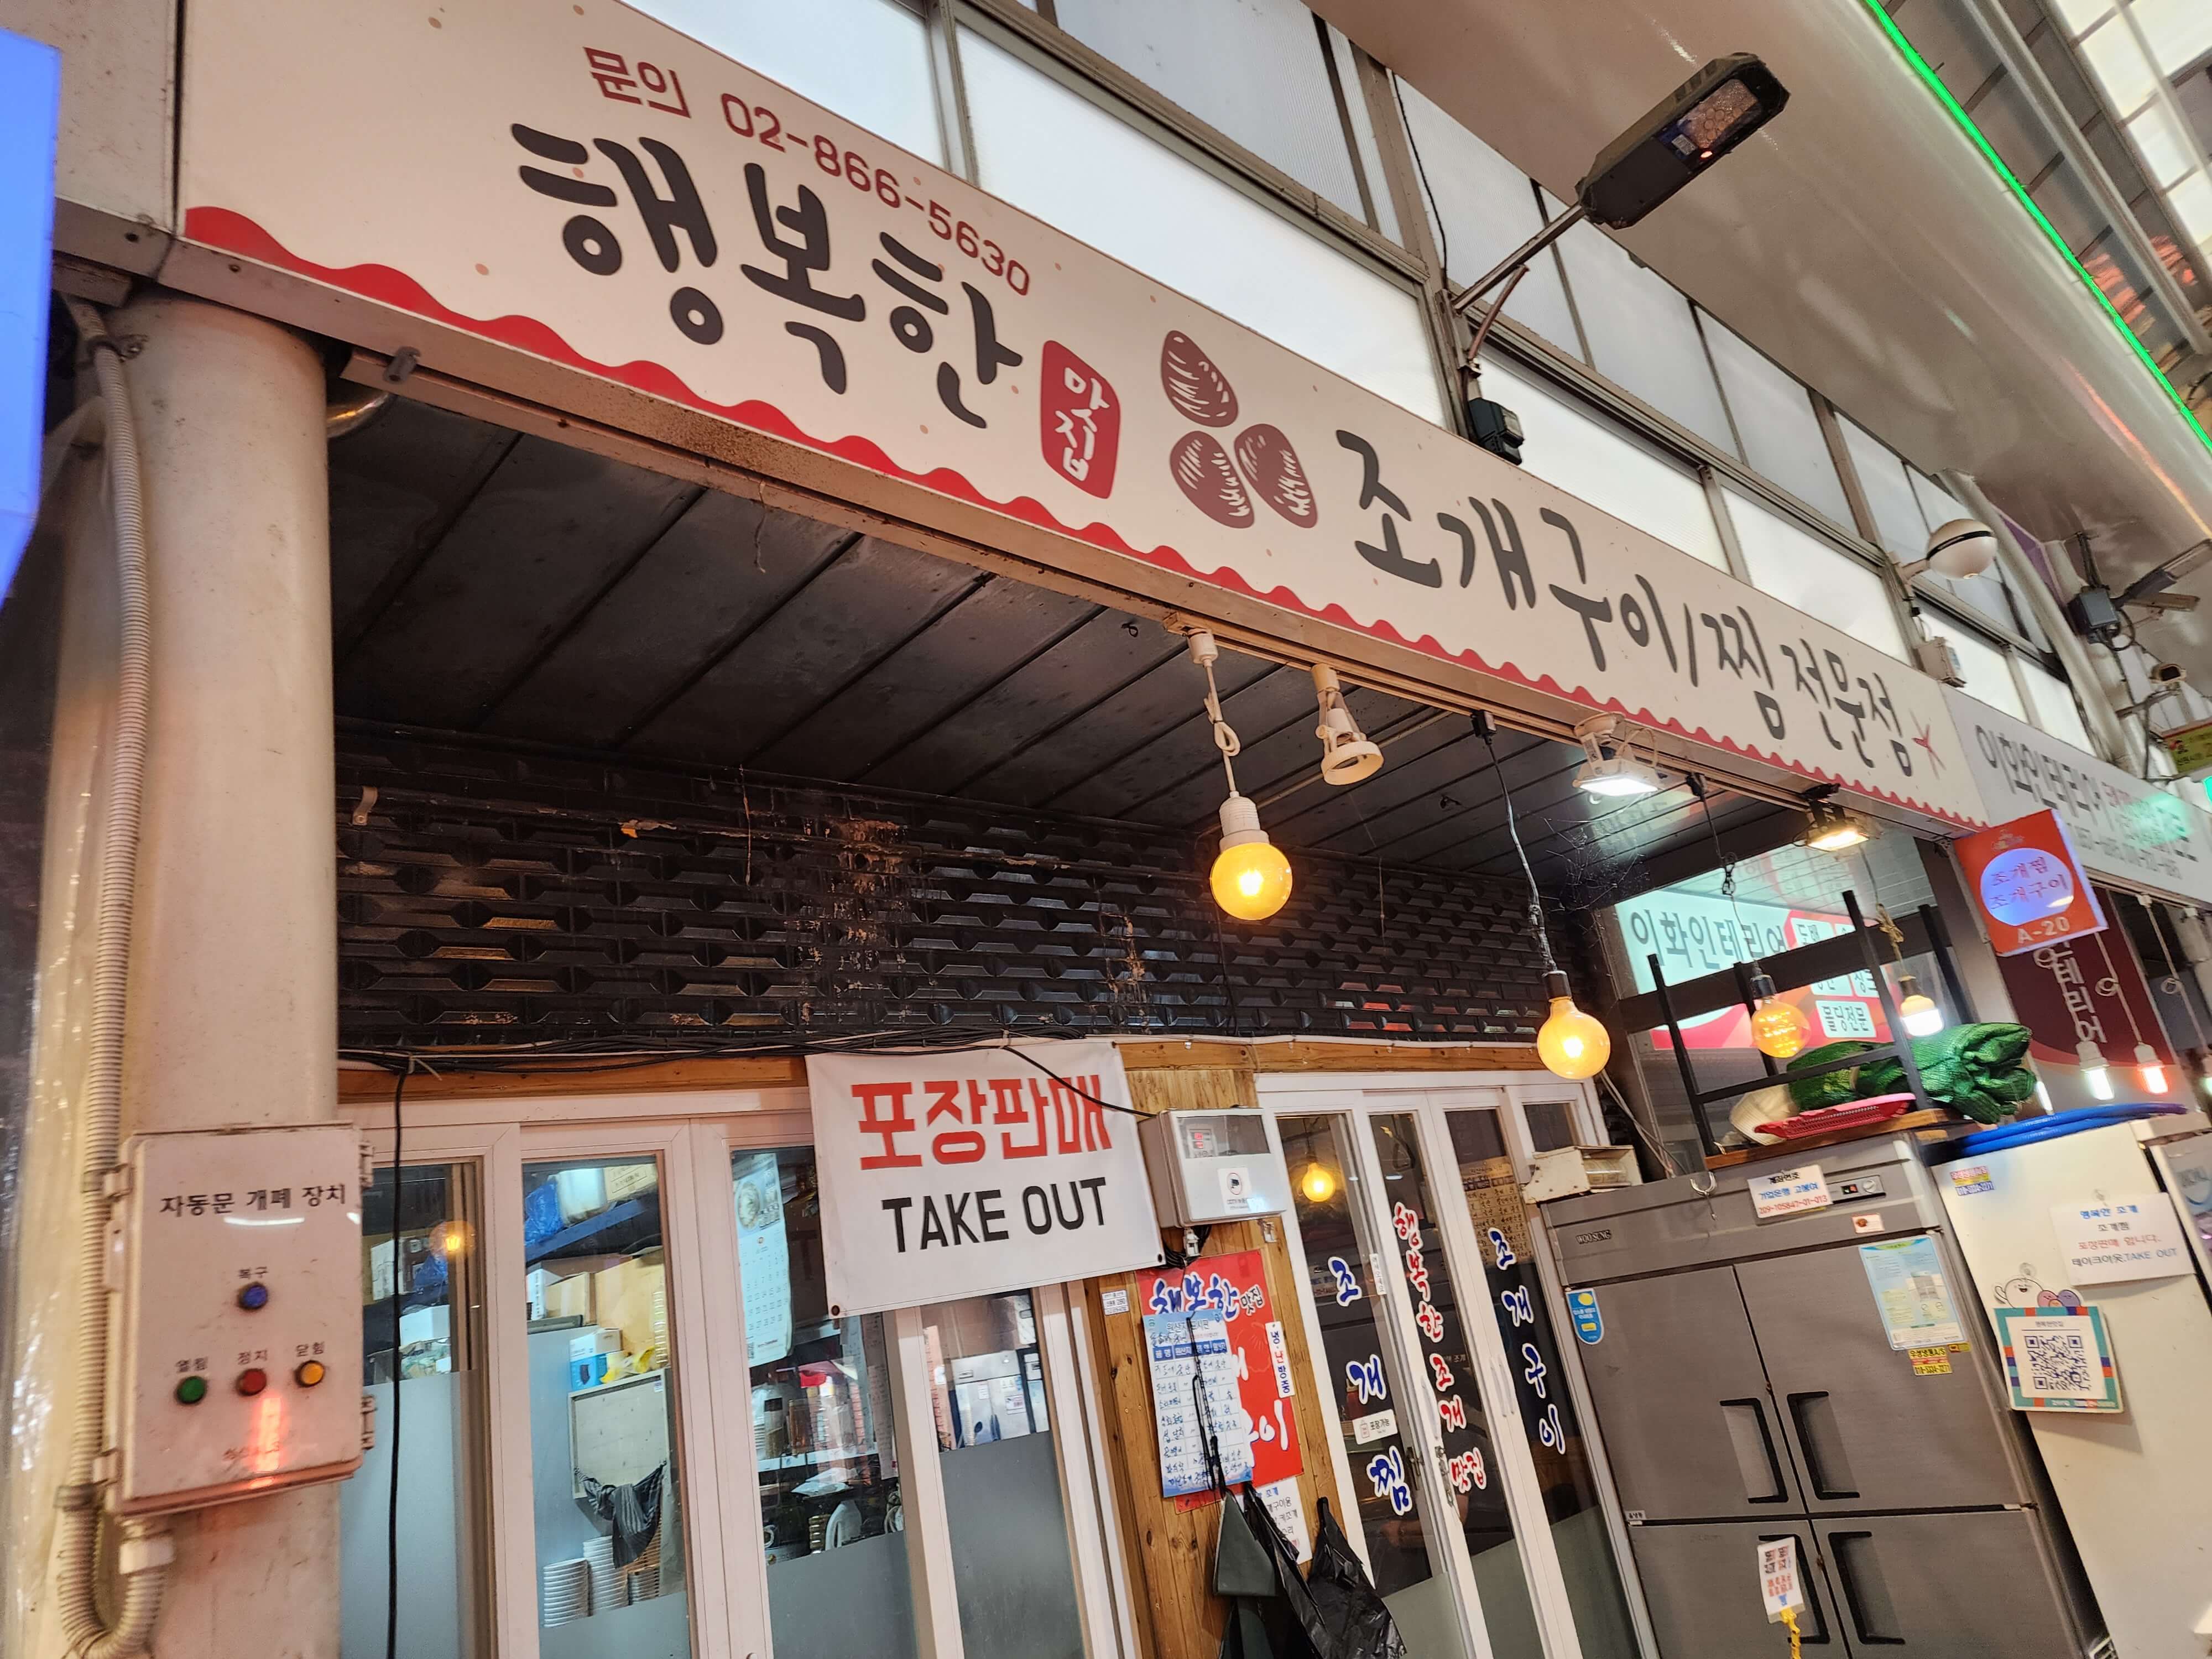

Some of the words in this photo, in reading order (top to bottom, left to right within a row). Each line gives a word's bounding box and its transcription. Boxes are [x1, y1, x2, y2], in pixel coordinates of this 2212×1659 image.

[583, 46, 691, 118] 문의
[721, 93, 1031, 296] 02-866-5630
[511, 122, 1023, 429] 행복한
[1054, 365, 1109, 482] 맛집
[1336, 429, 1786, 741] 조개구이/찜
[1779, 637, 1913, 778] 전문점
[1989, 874, 2069, 910] 조개구이
[2017, 916, 2070, 945] A-20
[1822, 1005, 1870, 1032] 몰딩전문
[851, 1074, 1112, 1171] 포장판매
[160, 1192, 235, 1218] 자동문
[246, 1187, 292, 1211] 개폐
[301, 1183, 347, 1208] 장치
[881, 1188, 1010, 1254] TAKE
[1022, 1176, 1107, 1235] OUT
[2078, 1239, 2120, 1250] 포장판매
[2156, 1248, 2178, 1258] OUT
[1240, 1286, 1264, 1314] 맛집
[1396, 1204, 1442, 1340] 행복한
[1431, 1355, 1465, 1431] 조개
[237, 1348, 268, 1365] 정지
[1490, 1229, 1564, 1453] 조개구이
[1330, 1258, 1410, 1512] 조개찜
